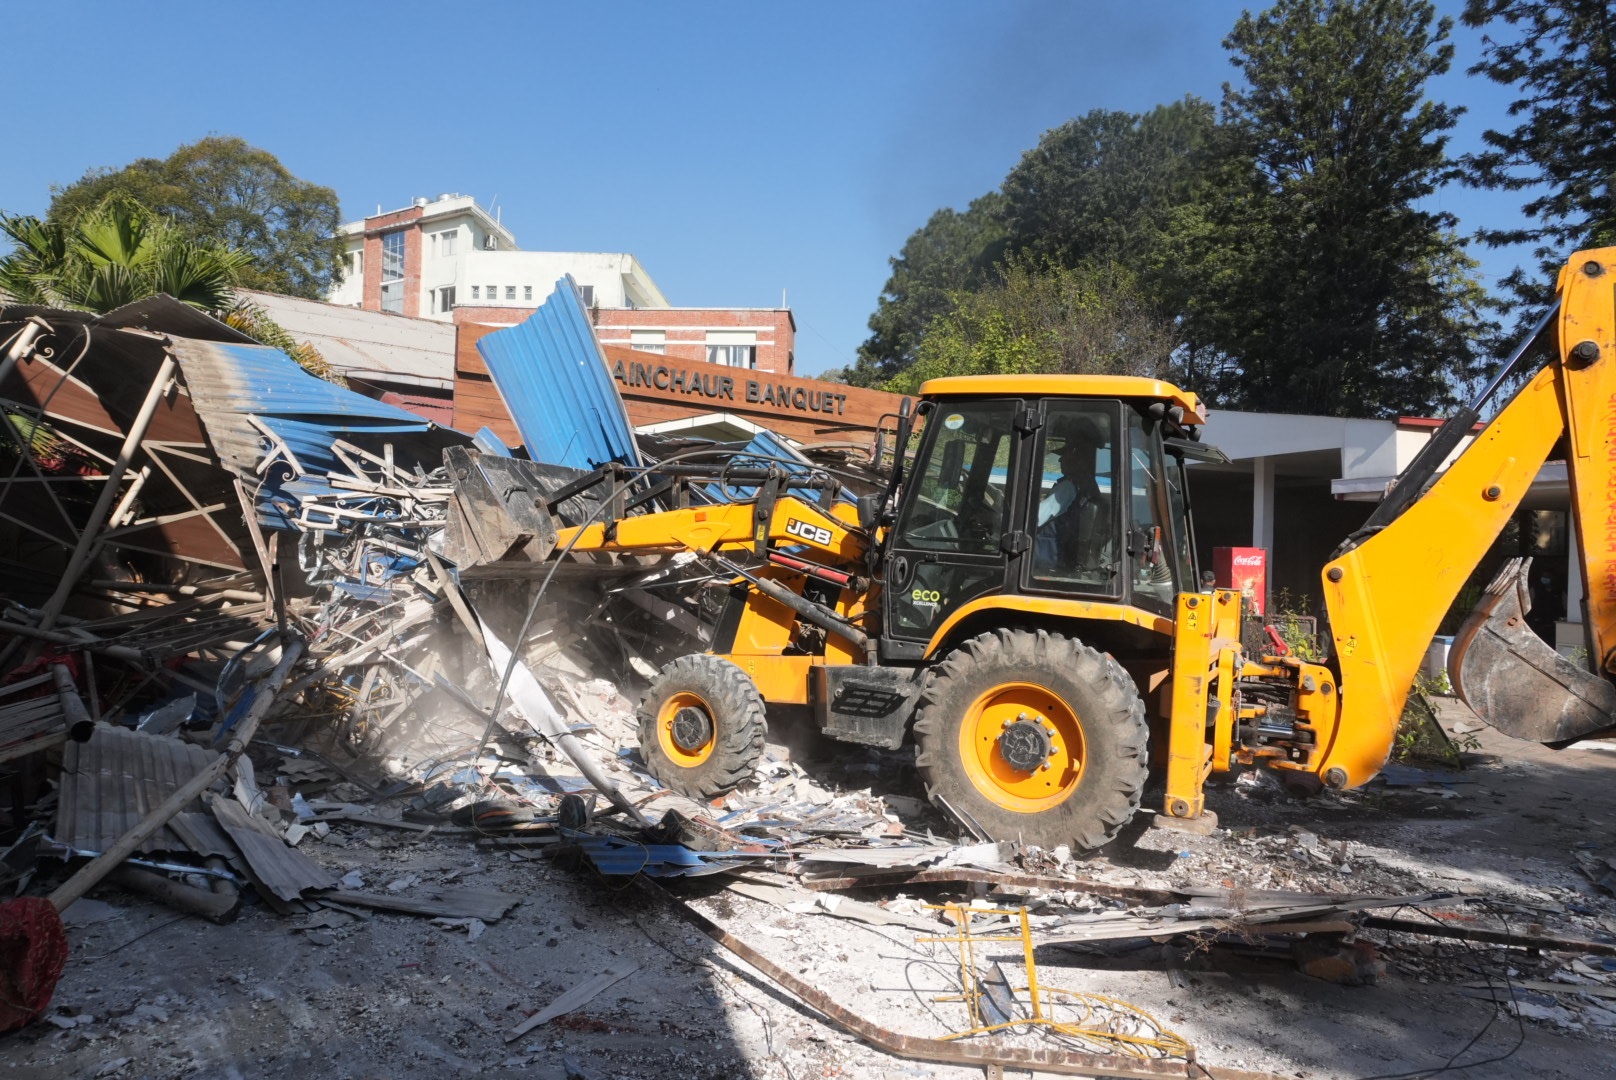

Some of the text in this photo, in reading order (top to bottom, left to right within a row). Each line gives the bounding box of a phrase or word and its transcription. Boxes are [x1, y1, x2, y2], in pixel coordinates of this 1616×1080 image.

[745, 380, 847, 415] BANQUET
[787, 519, 831, 545] JCB
[1233, 555, 1262, 566] Coca-Cola
[912, 589, 940, 602] eco
